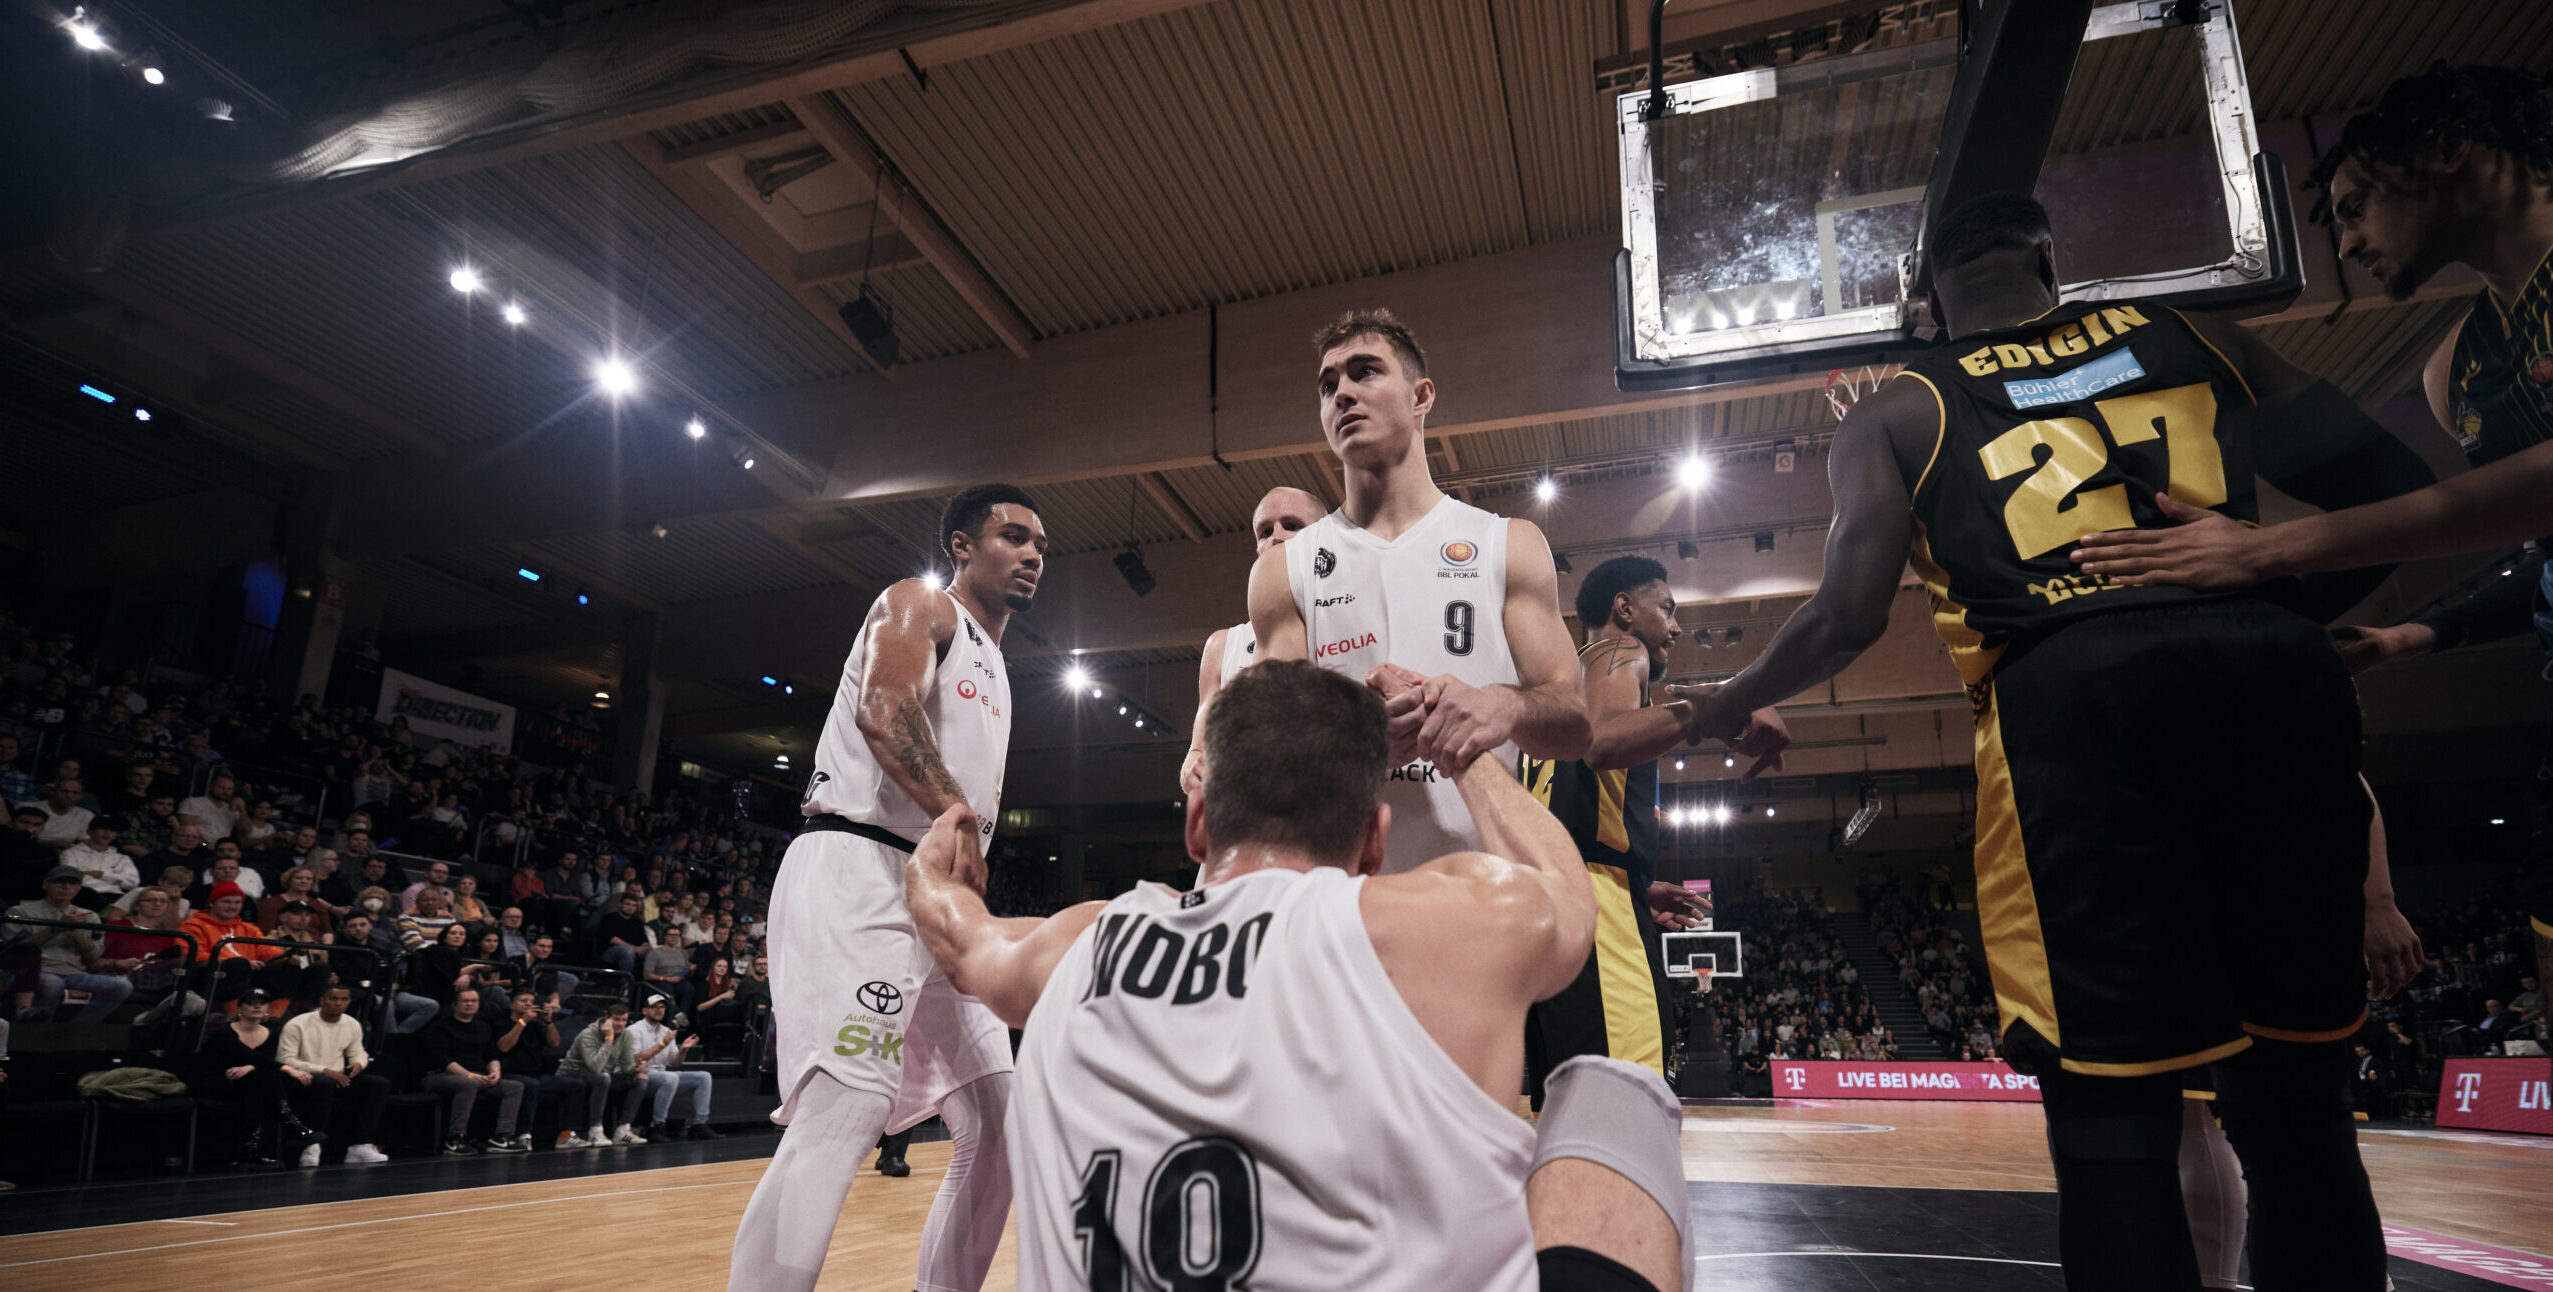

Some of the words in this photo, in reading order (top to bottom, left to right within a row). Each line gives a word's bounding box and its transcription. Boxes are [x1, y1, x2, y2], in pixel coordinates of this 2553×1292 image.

[1957, 304, 2152, 377] EDIGIN
[2008, 376, 2078, 398] Bühler
[2013, 367, 2142, 408] HealthCare
[1978, 381, 2228, 561] 27
[1437, 571, 1453, 579] BBL
[1454, 571, 1480, 579] POKAL
[1315, 595, 1344, 608] RAFT
[1443, 599, 1476, 657] 9
[1316, 632, 1378, 661] VEOLIA
[1384, 763, 1436, 784] ACK
[843, 1012, 897, 1030] Autohaus
[1837, 1071, 1876, 1088] LIVE
[1879, 1071, 1908, 1089] BEI
